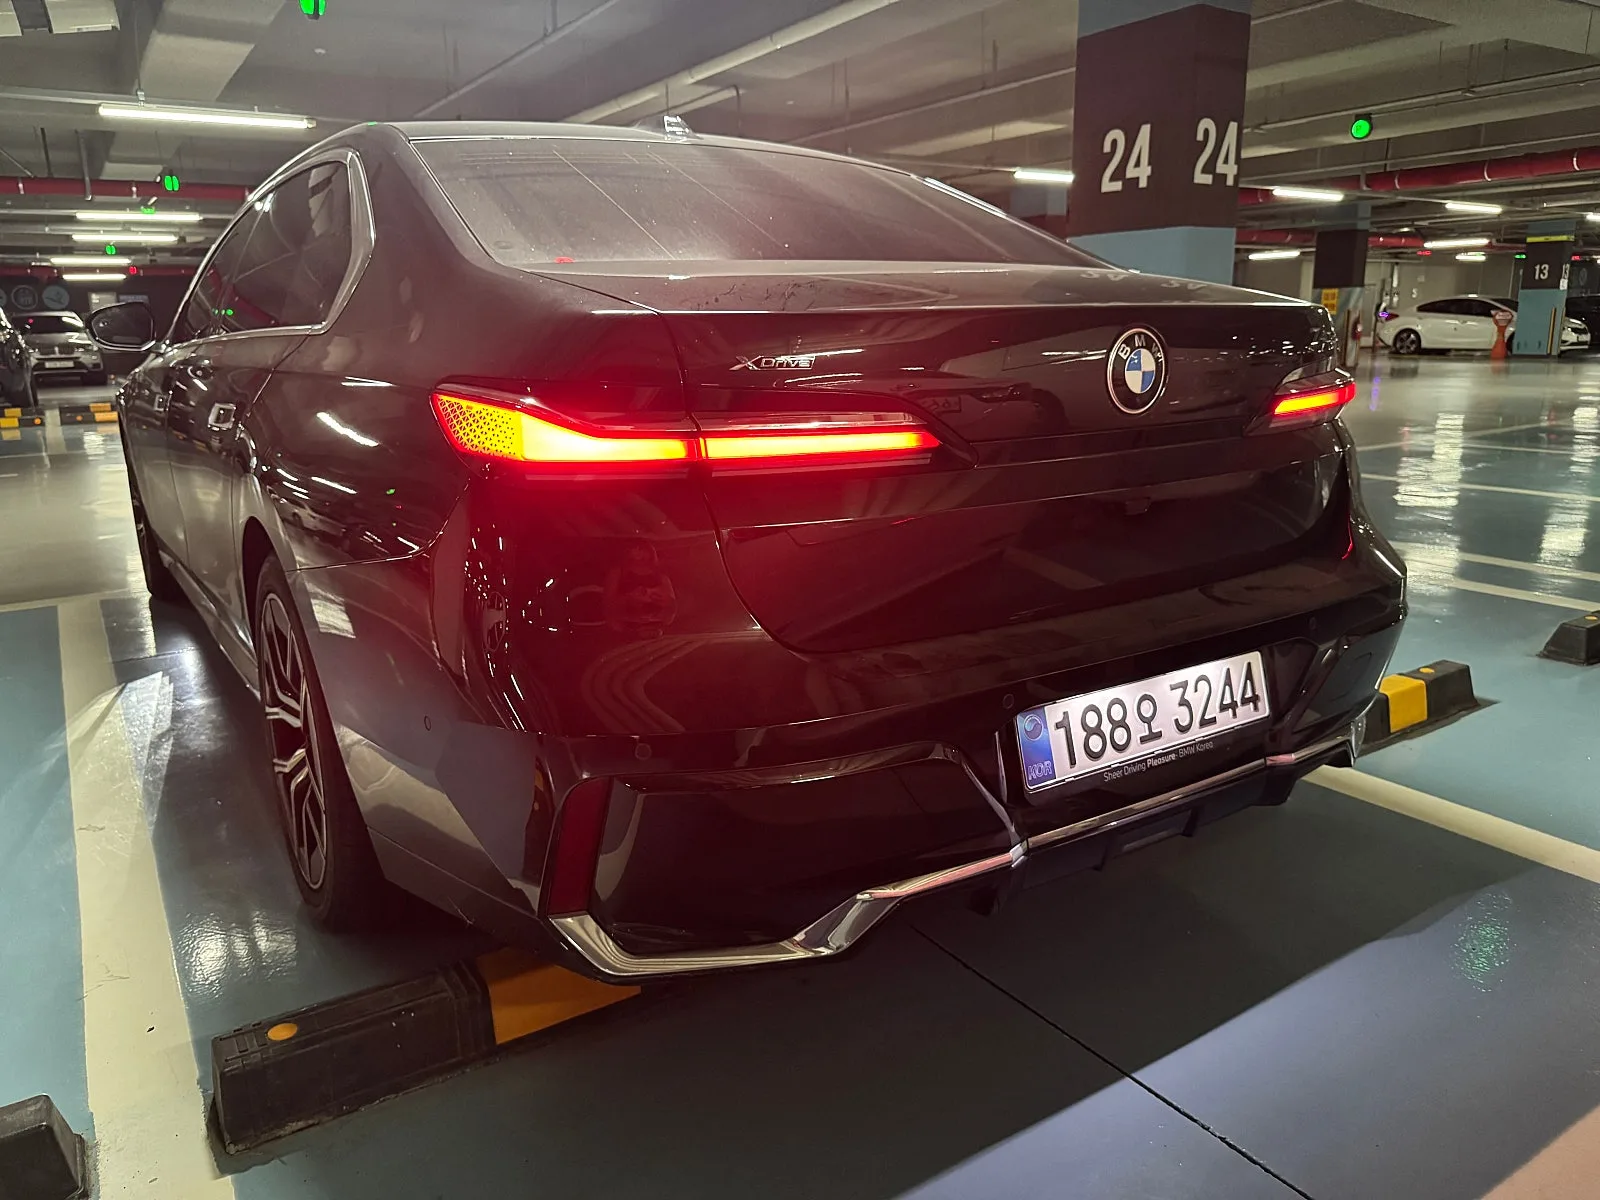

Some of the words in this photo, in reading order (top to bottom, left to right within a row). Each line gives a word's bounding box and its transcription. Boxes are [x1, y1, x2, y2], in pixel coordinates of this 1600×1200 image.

[1101, 124, 1152, 193] 24
[1194, 117, 1238, 187] 24
[1534, 264, 1549, 280] 13
[1118, 334, 1164, 363] BMW
[1054, 693, 1163, 769] 188오
[1169, 661, 1261, 735] 3244
[1027, 760, 1053, 781] KOR
[1103, 770, 1123, 782] Sheer
[1124, 762, 1146, 775] Driving
[1178, 746, 1196, 758] BMW
[1196, 741, 1214, 752] Korea
